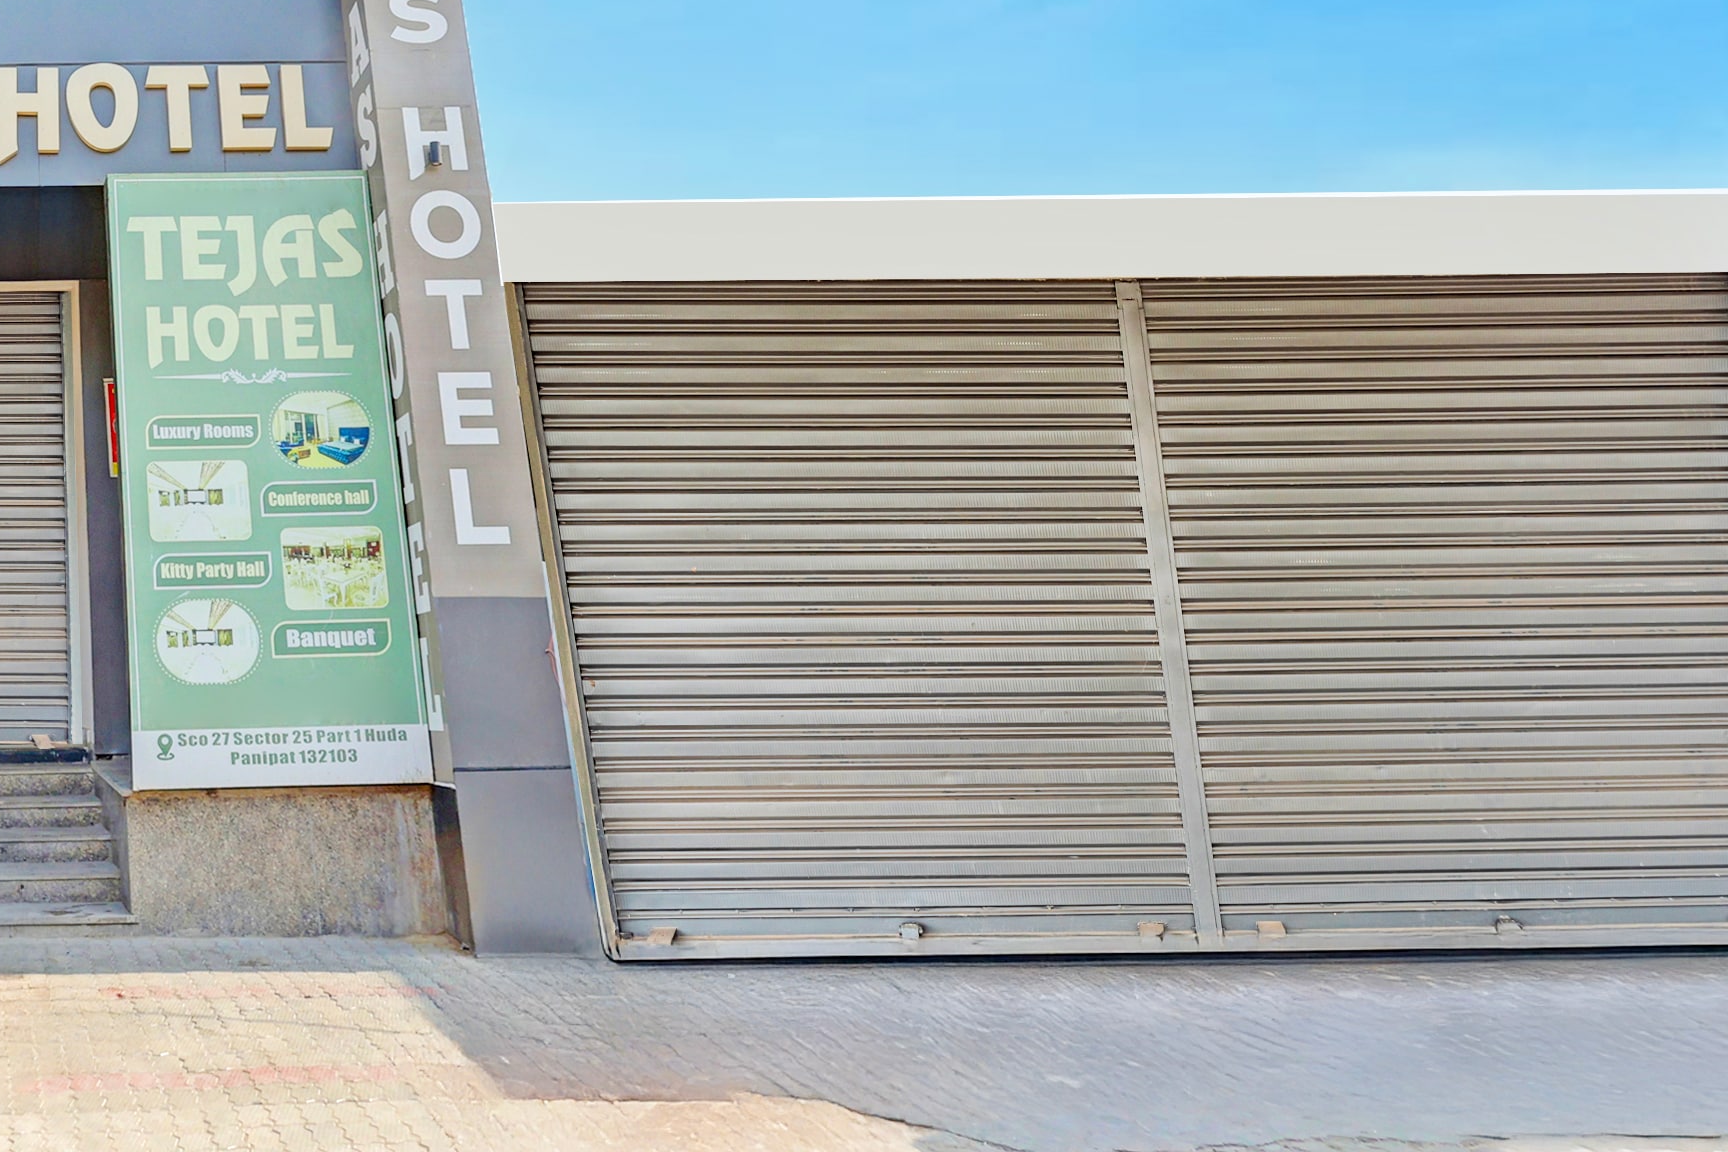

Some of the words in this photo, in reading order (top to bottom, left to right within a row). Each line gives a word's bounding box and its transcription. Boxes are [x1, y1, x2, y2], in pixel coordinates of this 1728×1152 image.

[126, 208, 363, 297] TEJAS
[401, 105, 512, 545] HOTEL
[144, 304, 355, 369] HOTEL
[153, 423, 201, 442] Luxury
[203, 424, 254, 440] Rooms
[268, 491, 343, 507] Conference
[344, 489, 370, 504] hall
[160, 562, 194, 580] Kitty
[196, 561, 235, 579] Party
[236, 559, 265, 577] Hall
[286, 628, 377, 649] Banquet
[177, 733, 209, 747] Sco
[211, 732, 230, 746] 27
[233, 730, 289, 745] Sector
[294, 730, 313, 744] 25
[316, 728, 351, 743] Part
[354, 728, 362, 742] 1
[365, 728, 408, 742] Huda
[230, 750, 296, 766] Panipat
[300, 748, 358, 763] 132103
